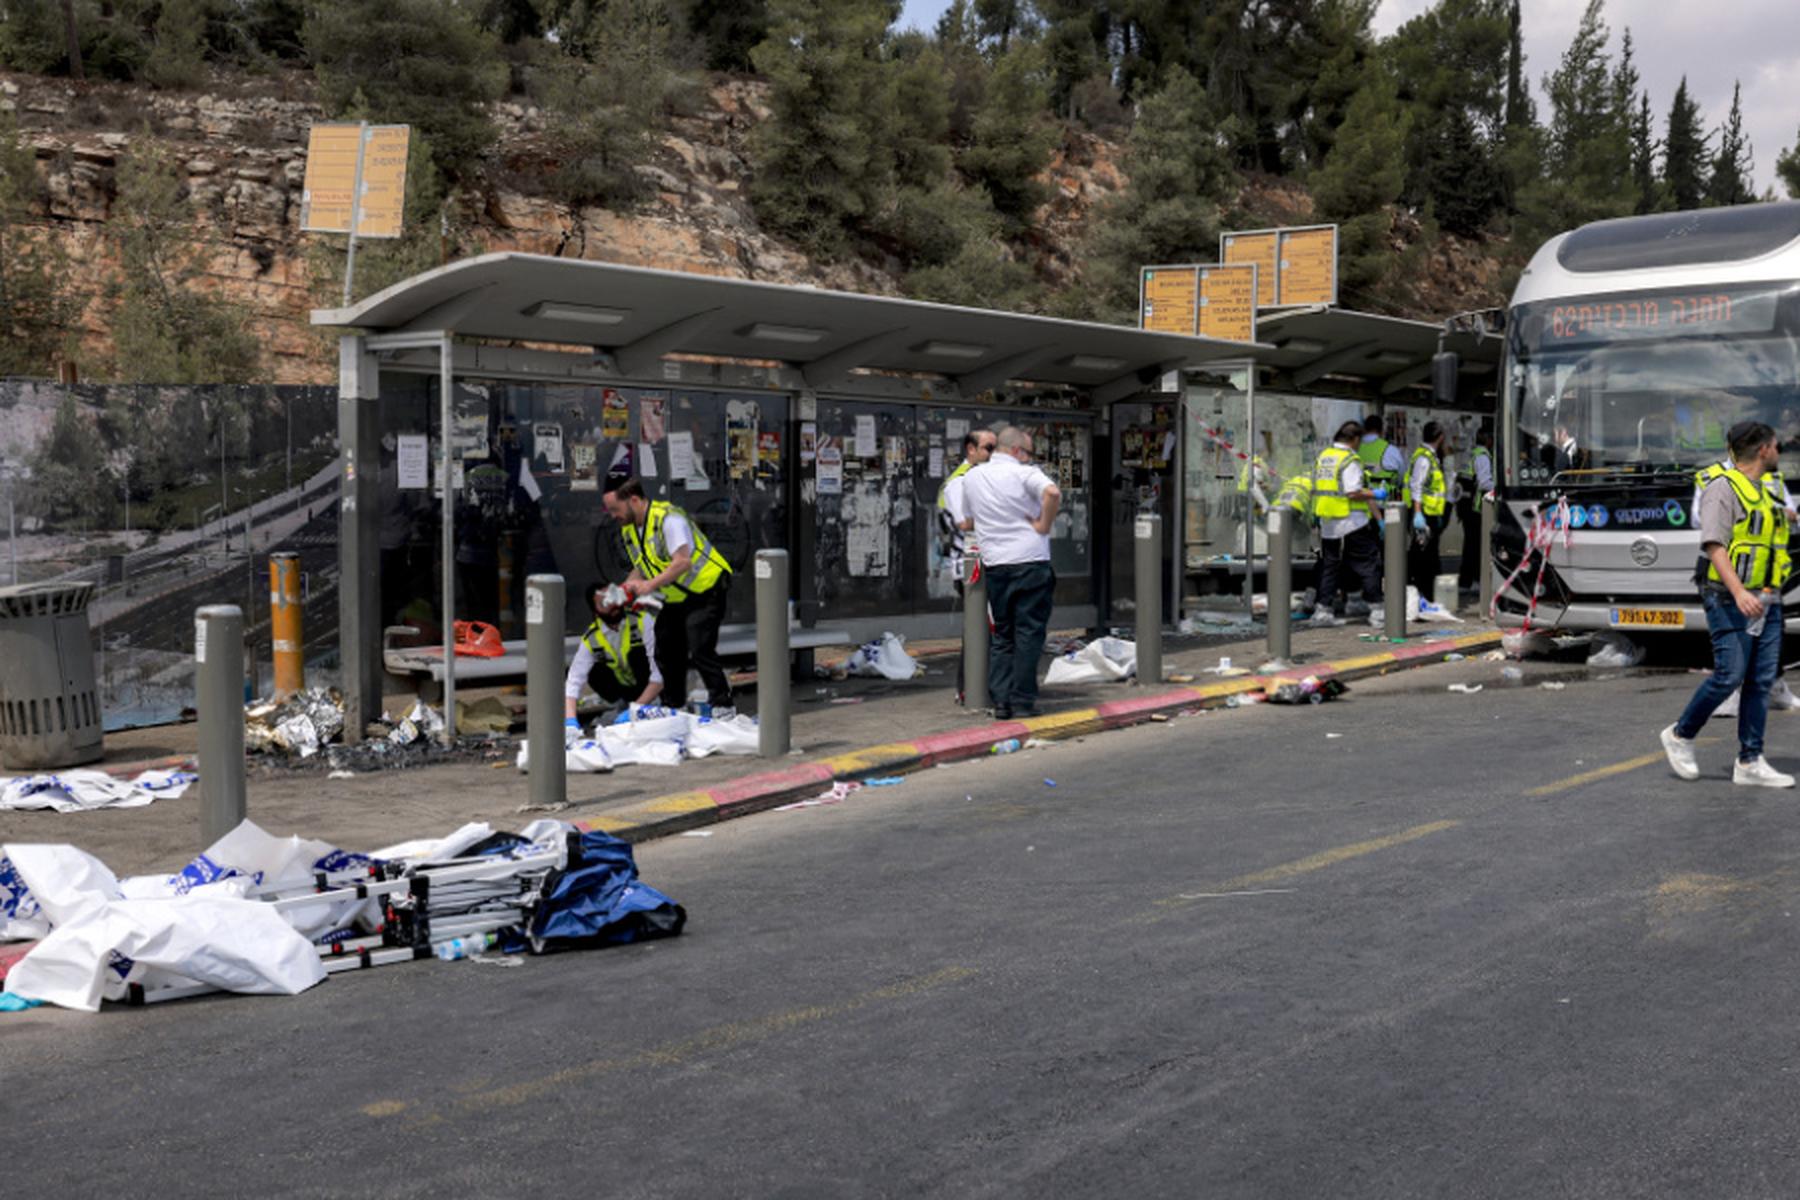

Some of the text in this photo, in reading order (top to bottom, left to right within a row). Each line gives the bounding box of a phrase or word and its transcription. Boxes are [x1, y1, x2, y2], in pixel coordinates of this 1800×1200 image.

[1552, 294, 1731, 337] תחנה מרכזית 62
